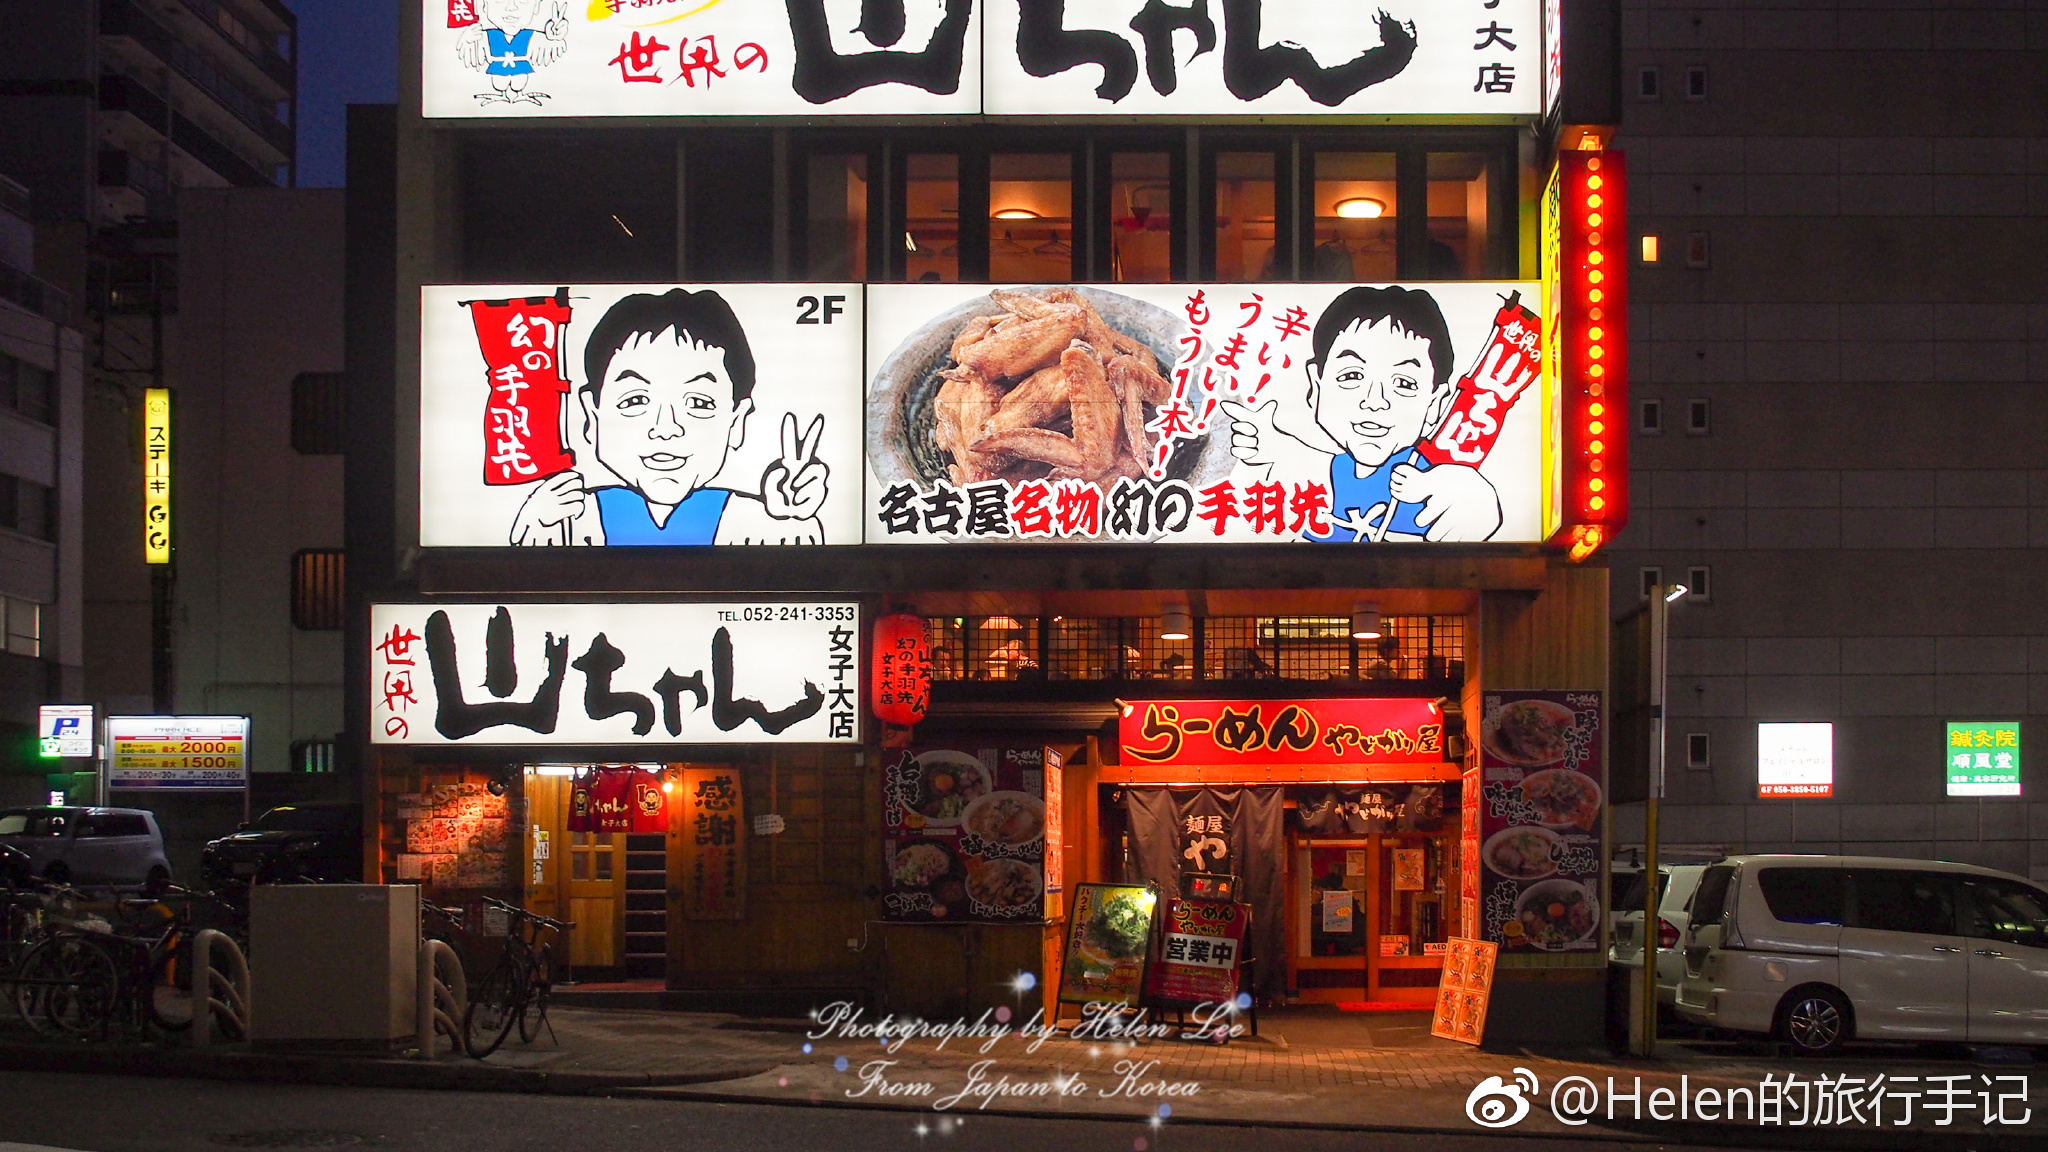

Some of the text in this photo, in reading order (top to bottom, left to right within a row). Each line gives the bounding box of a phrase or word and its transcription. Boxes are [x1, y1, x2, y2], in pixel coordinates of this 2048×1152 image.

[607, 31, 768, 91] 世界の
[1473, 0, 1518, 94] 大店
[796, 295, 846, 325] 2F
[1502, 320, 1541, 363] 世界の
[490, 312, 555, 480] 幻の手羽先
[1434, 342, 1533, 463] 山ちゃん
[149, 426, 166, 494] ステーキ
[375, 623, 422, 741] 世界の
[424, 606, 826, 740] 山ちゃん
[828, 625, 855, 740] 女子大店
[880, 652, 895, 705] 女子大店
[896, 637, 917, 705] 幻の手羽先
[52, 718, 80, 736] P
[180, 742, 226, 753] 2000
[1122, 704, 1319, 762] らーめん
[1950, 730, 2018, 748] 鍼灸院
[181, 756, 226, 768] 1500
[1761, 786, 1772, 794] 6F
[693, 775, 738, 846] 感謝
[1172, 901, 1235, 922] らーめん
[1166, 937, 1233, 965] 営業中
